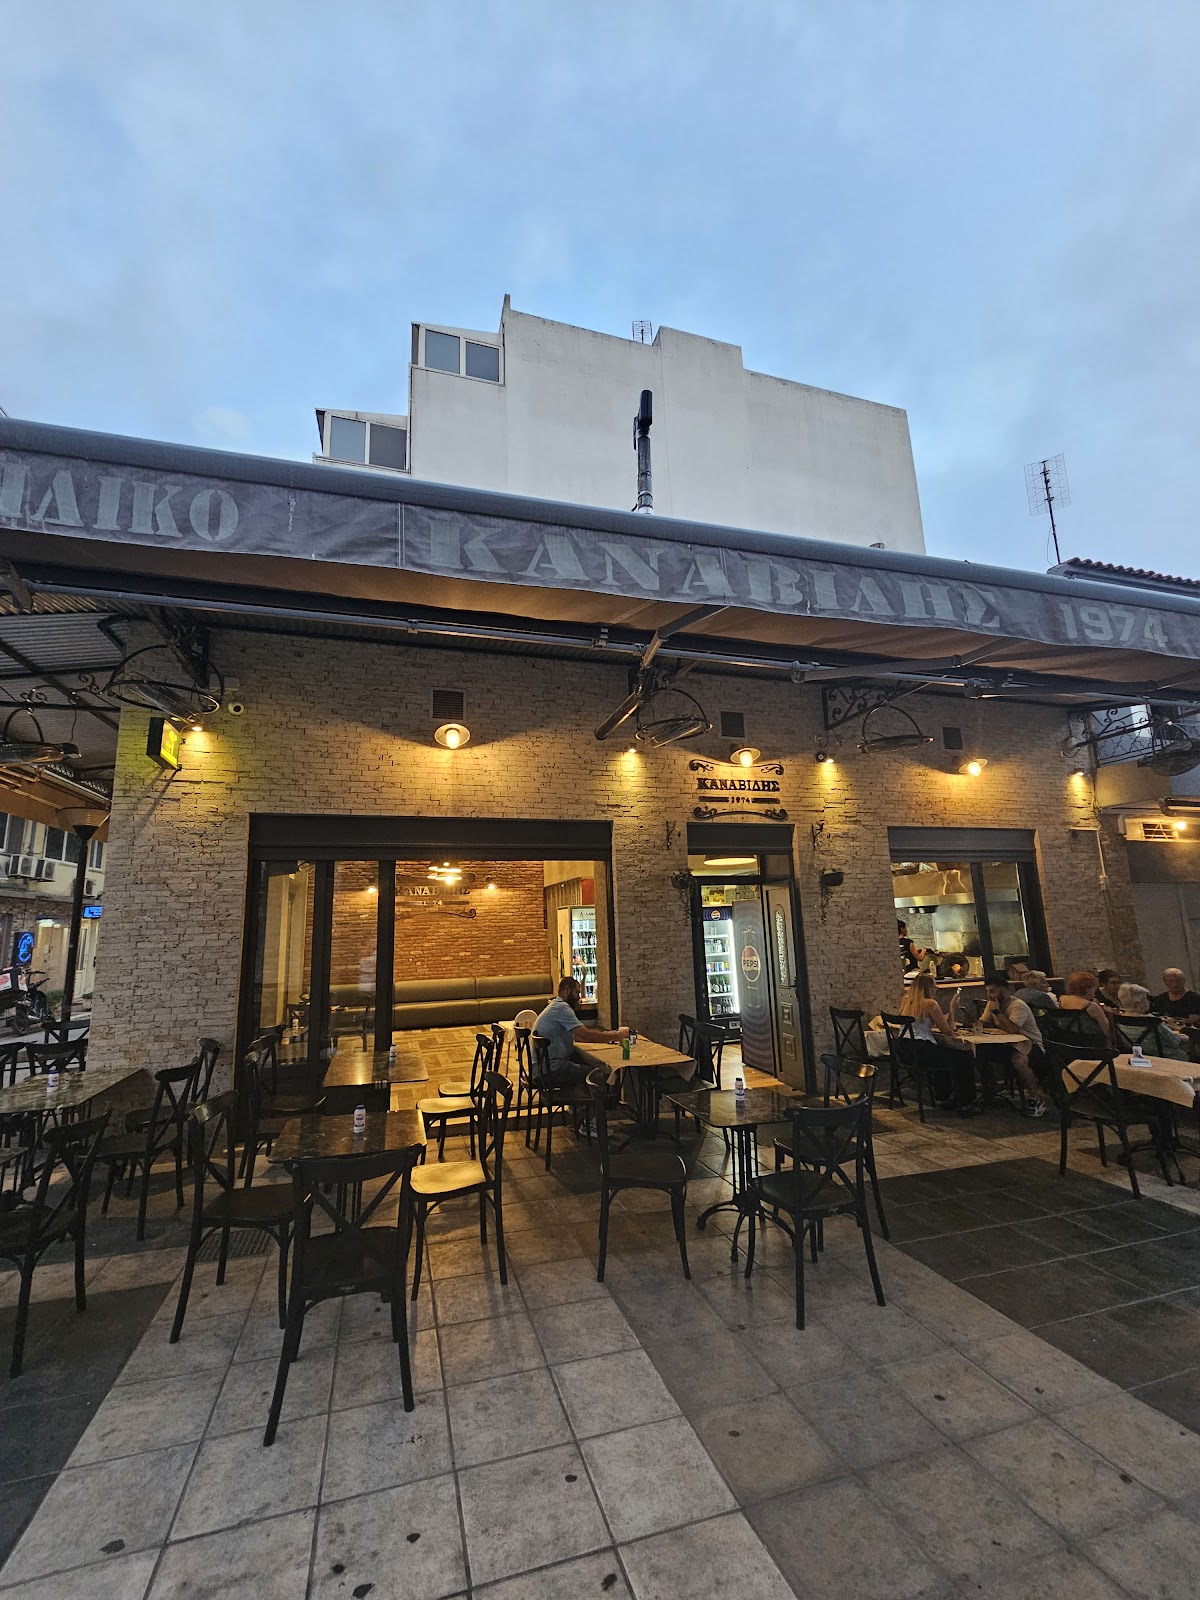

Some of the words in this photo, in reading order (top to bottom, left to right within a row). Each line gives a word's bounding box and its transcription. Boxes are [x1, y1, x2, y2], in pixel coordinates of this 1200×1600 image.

[428, 521, 1001, 628] ΚΑΝΑΒΙΔΗΣ
[1059, 602, 1168, 648] 1974
[697, 778, 780, 791] ΚΑΝΑΒΙΔΗΣ
[743, 959, 759, 968] PEPSI
